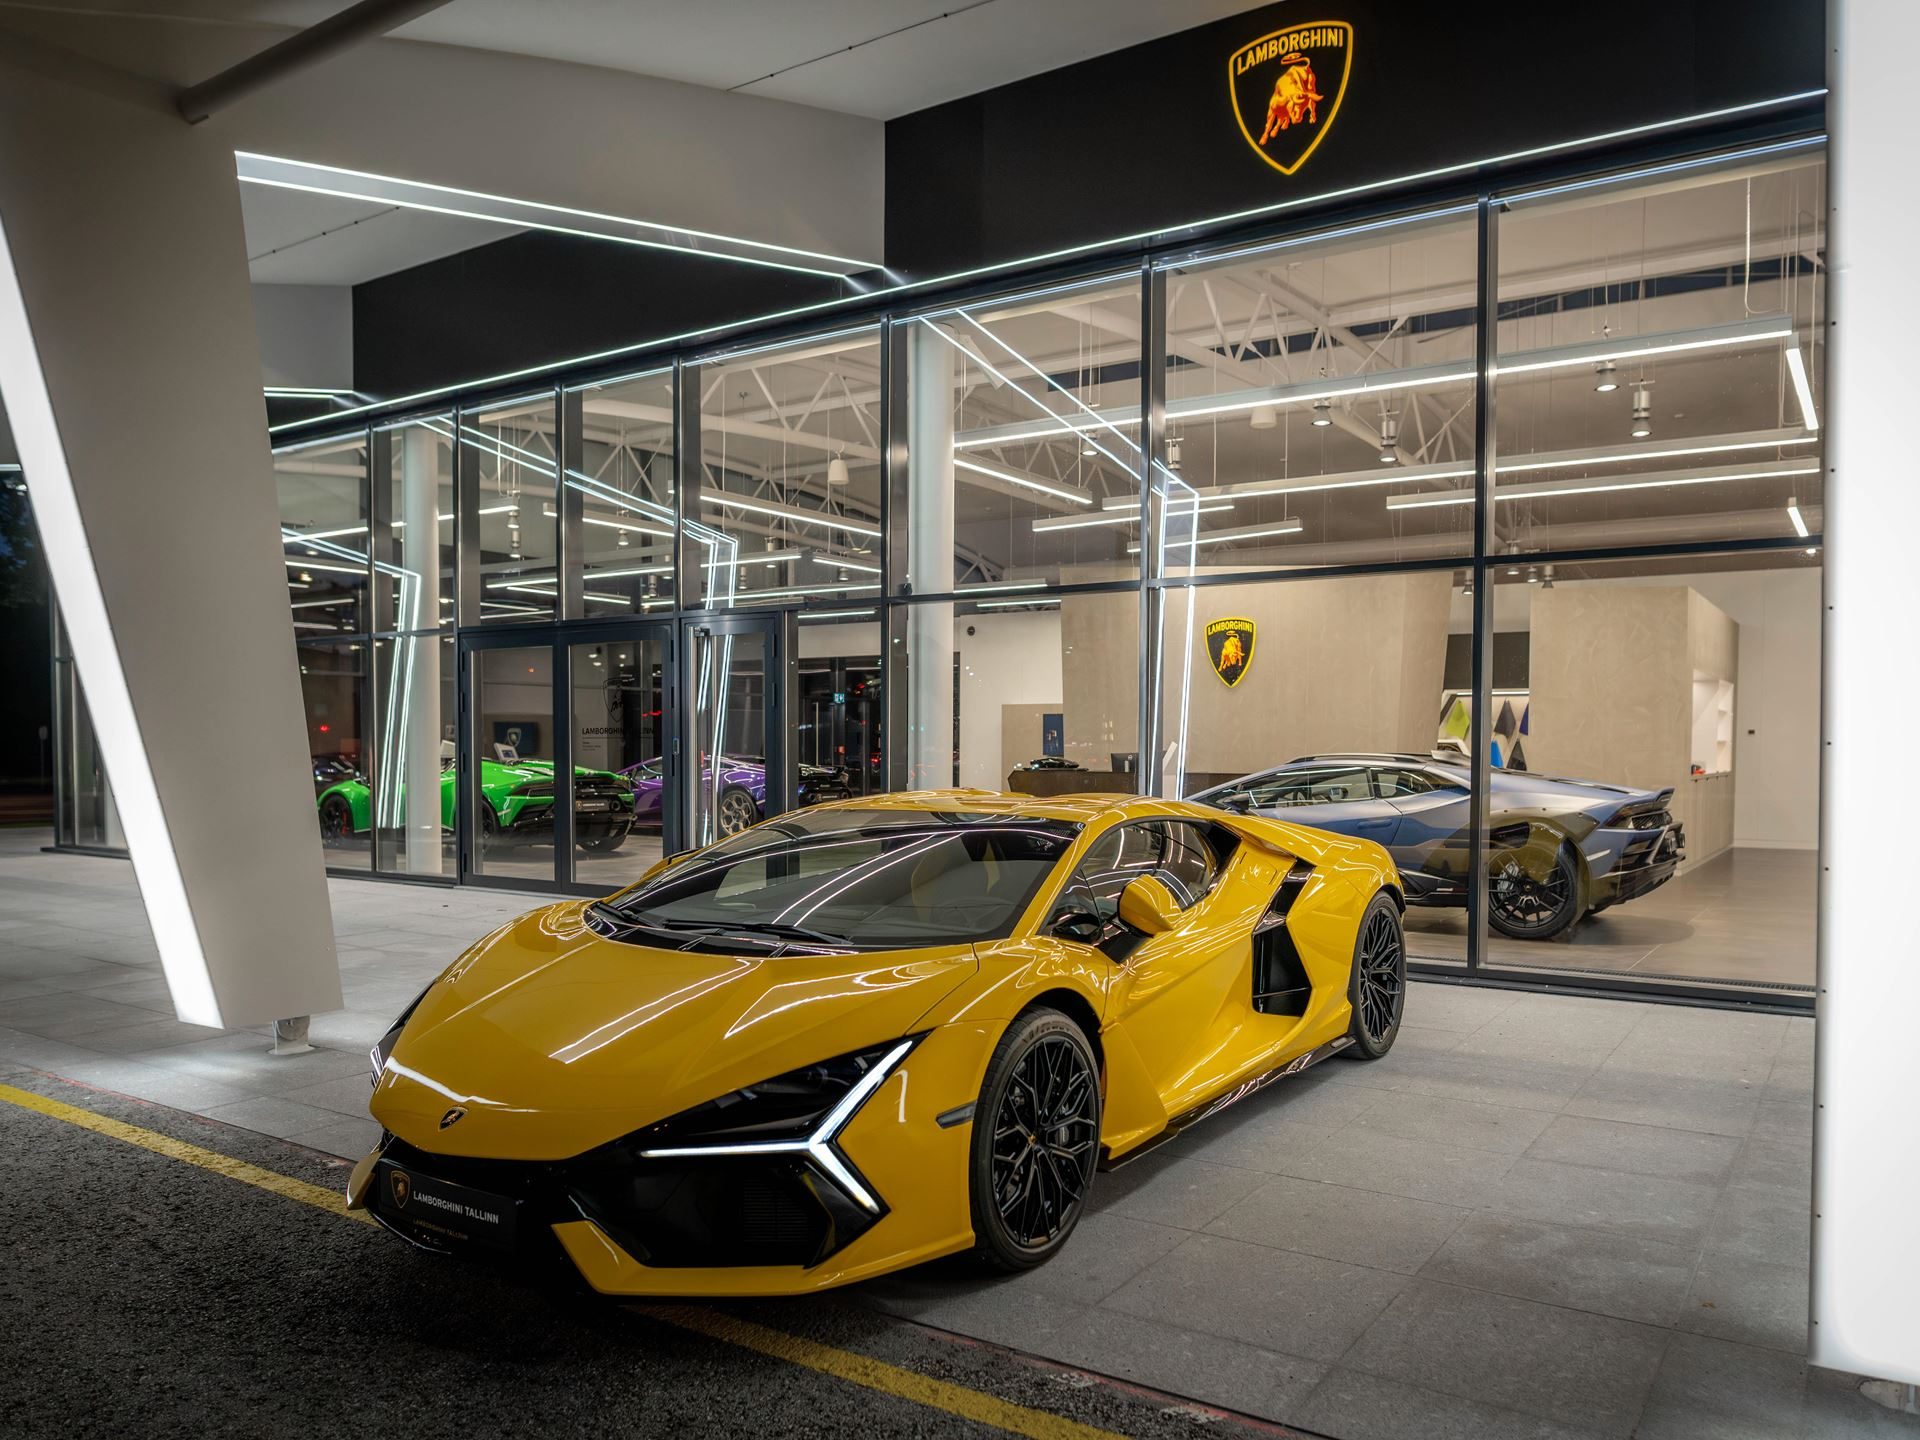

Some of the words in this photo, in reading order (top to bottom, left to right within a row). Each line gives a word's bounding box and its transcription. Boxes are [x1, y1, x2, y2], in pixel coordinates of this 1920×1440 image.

[1237, 28, 1344, 76] LAMBORGHINI
[1207, 621, 1253, 636] LAMBORGHINI
[582, 727, 626, 735] LAMBORGHIN
[413, 1190, 463, 1214] LAMBORGHINI
[464, 1206, 499, 1224] TALLINN
